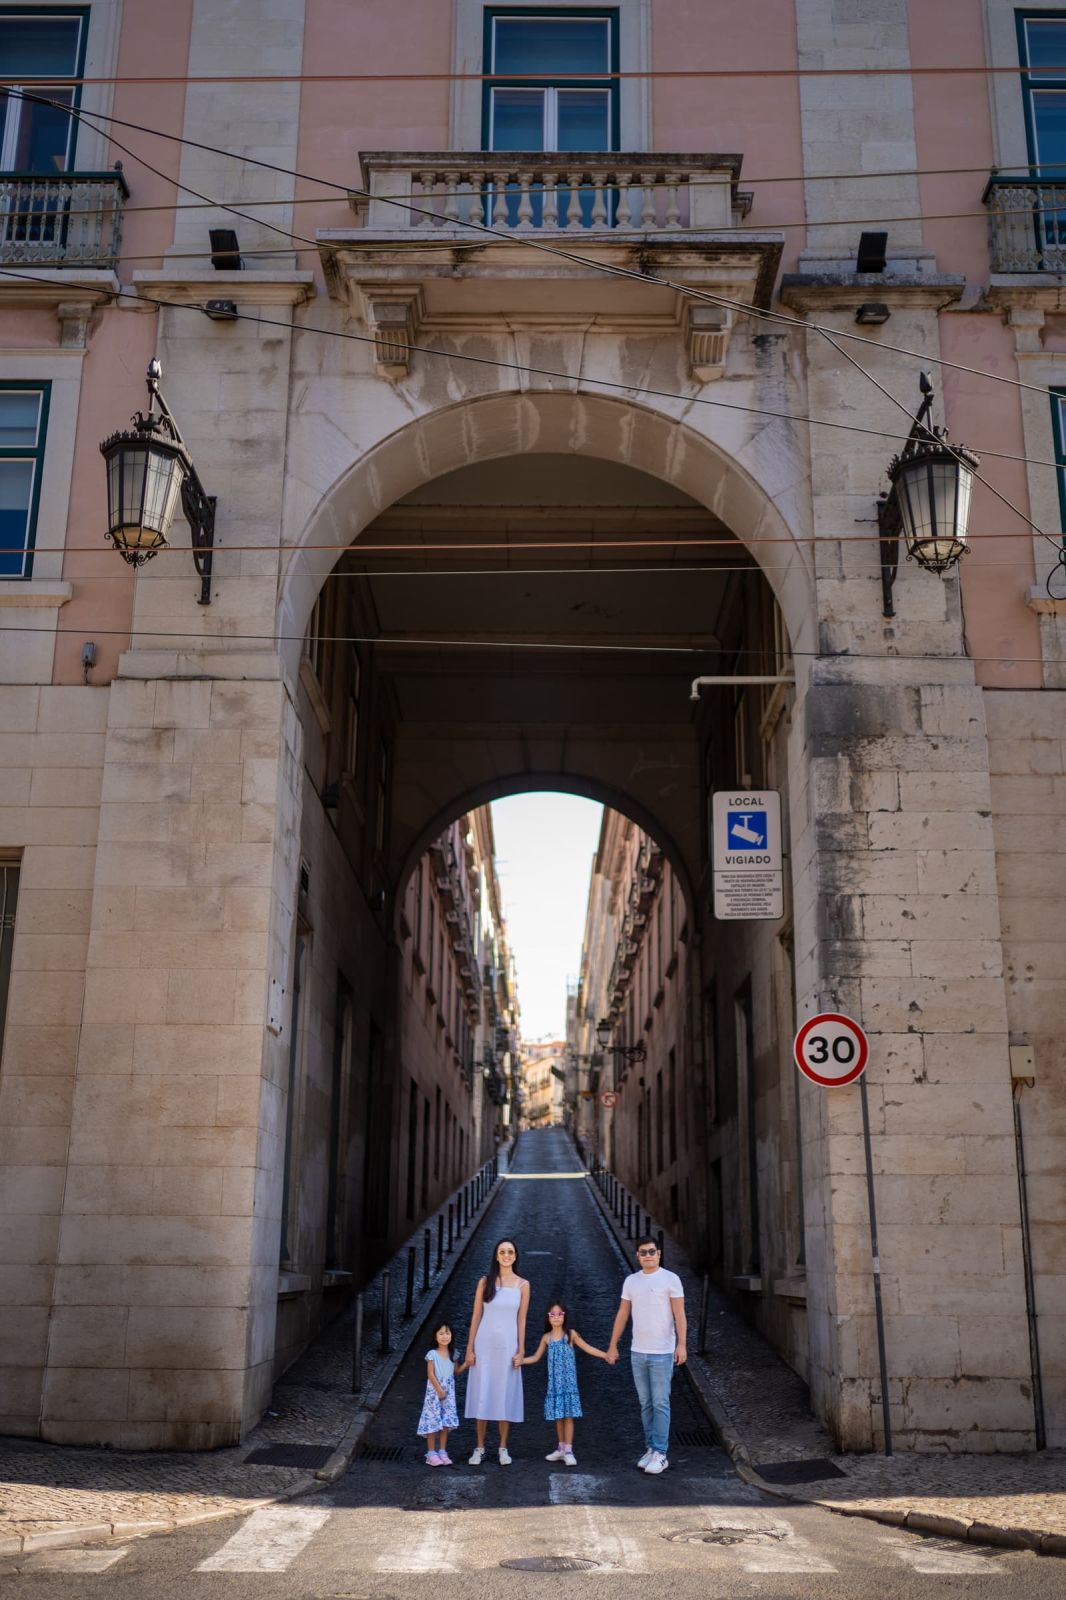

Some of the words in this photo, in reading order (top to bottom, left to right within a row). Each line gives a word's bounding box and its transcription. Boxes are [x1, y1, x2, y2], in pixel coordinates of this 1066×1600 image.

[729, 798, 764, 806] LOCAL
[725, 856, 771, 865] VIGIADO
[808, 1036, 855, 1064] 30
